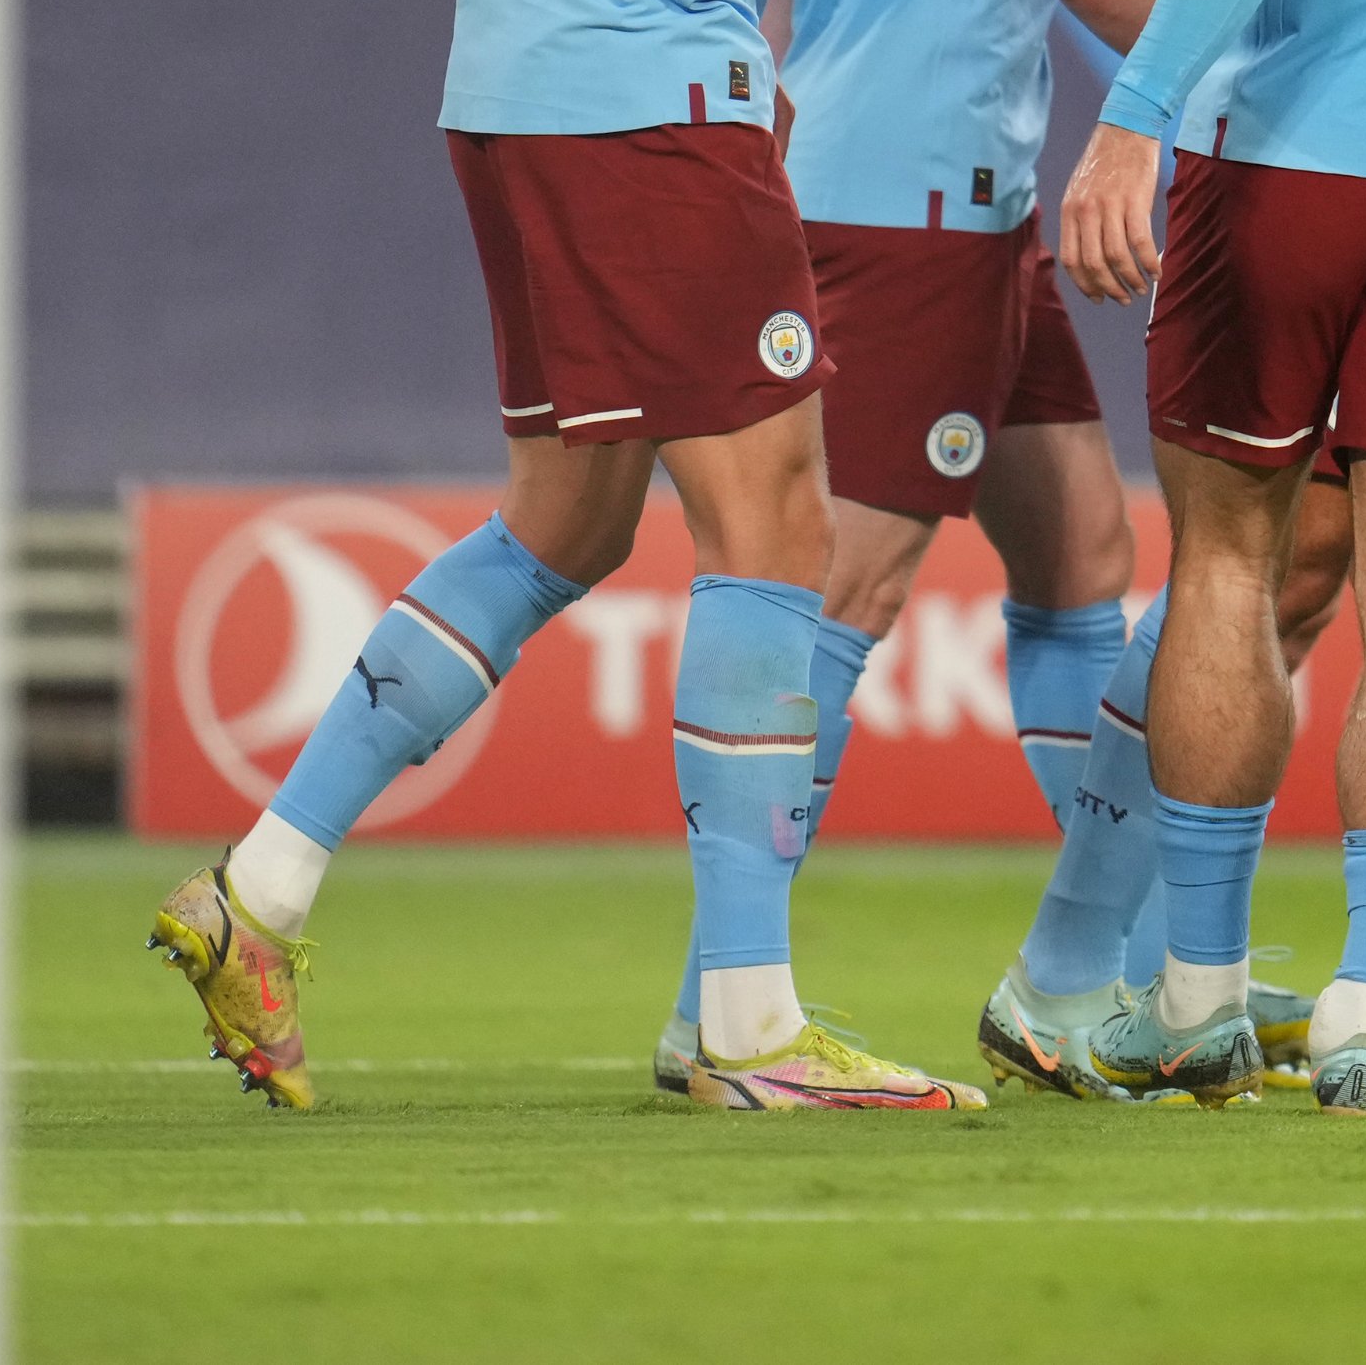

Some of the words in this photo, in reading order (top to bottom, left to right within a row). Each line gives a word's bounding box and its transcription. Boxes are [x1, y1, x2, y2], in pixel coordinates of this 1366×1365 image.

[762, 315, 806, 341] MANCHESTER
[782, 366, 799, 376] CITY
[1075, 786, 1128, 824] CITY
